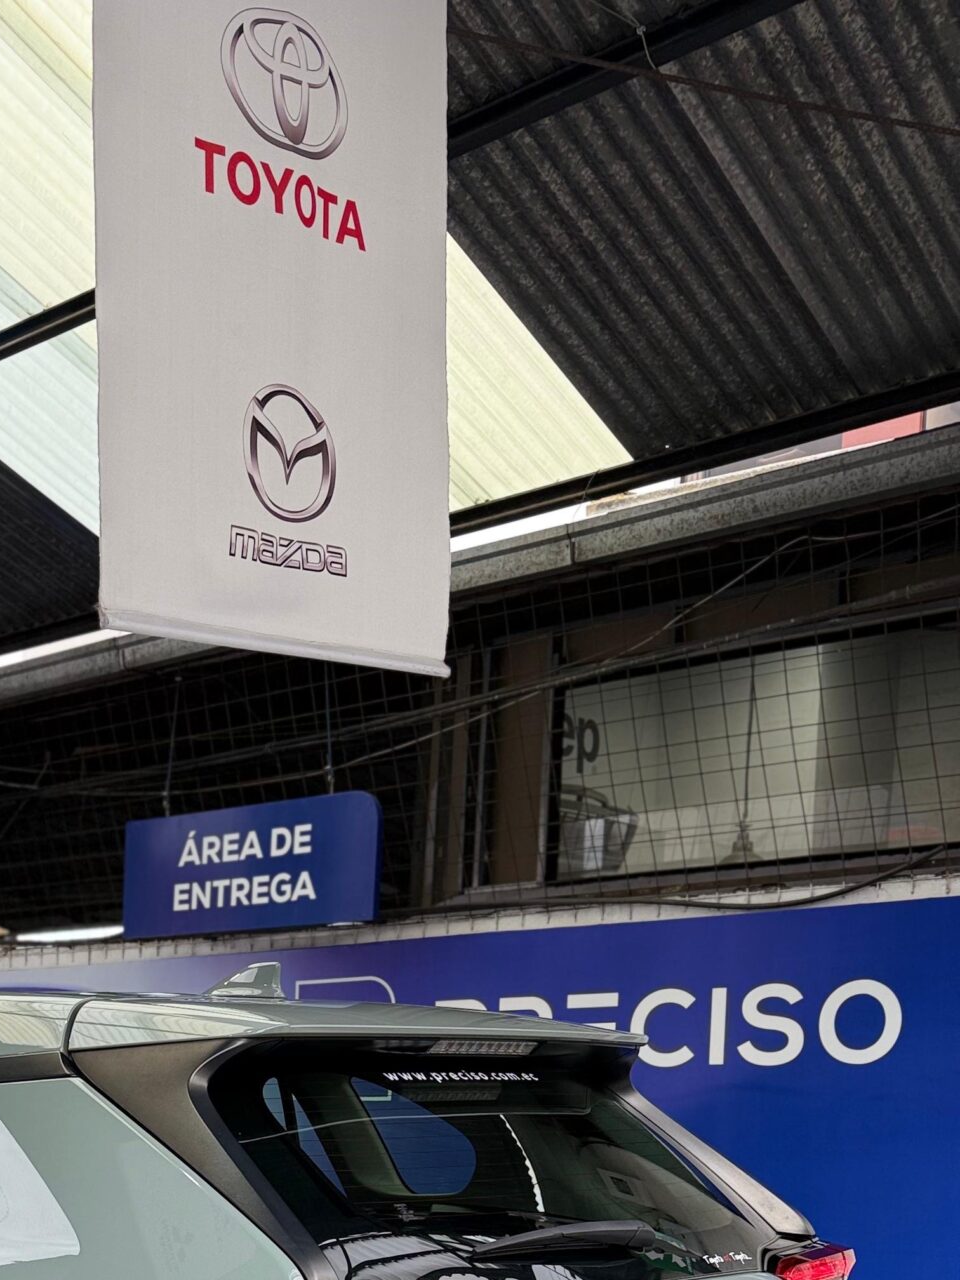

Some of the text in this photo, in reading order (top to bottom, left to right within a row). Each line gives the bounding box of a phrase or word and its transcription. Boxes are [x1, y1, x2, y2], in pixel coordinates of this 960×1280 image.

[195, 137, 366, 251] TOYOTA
[178, 823, 313, 867] ÁREA DE
[172, 871, 316, 912] ENTREGA
[382, 1069, 539, 1084] www.preciso.com.ec
